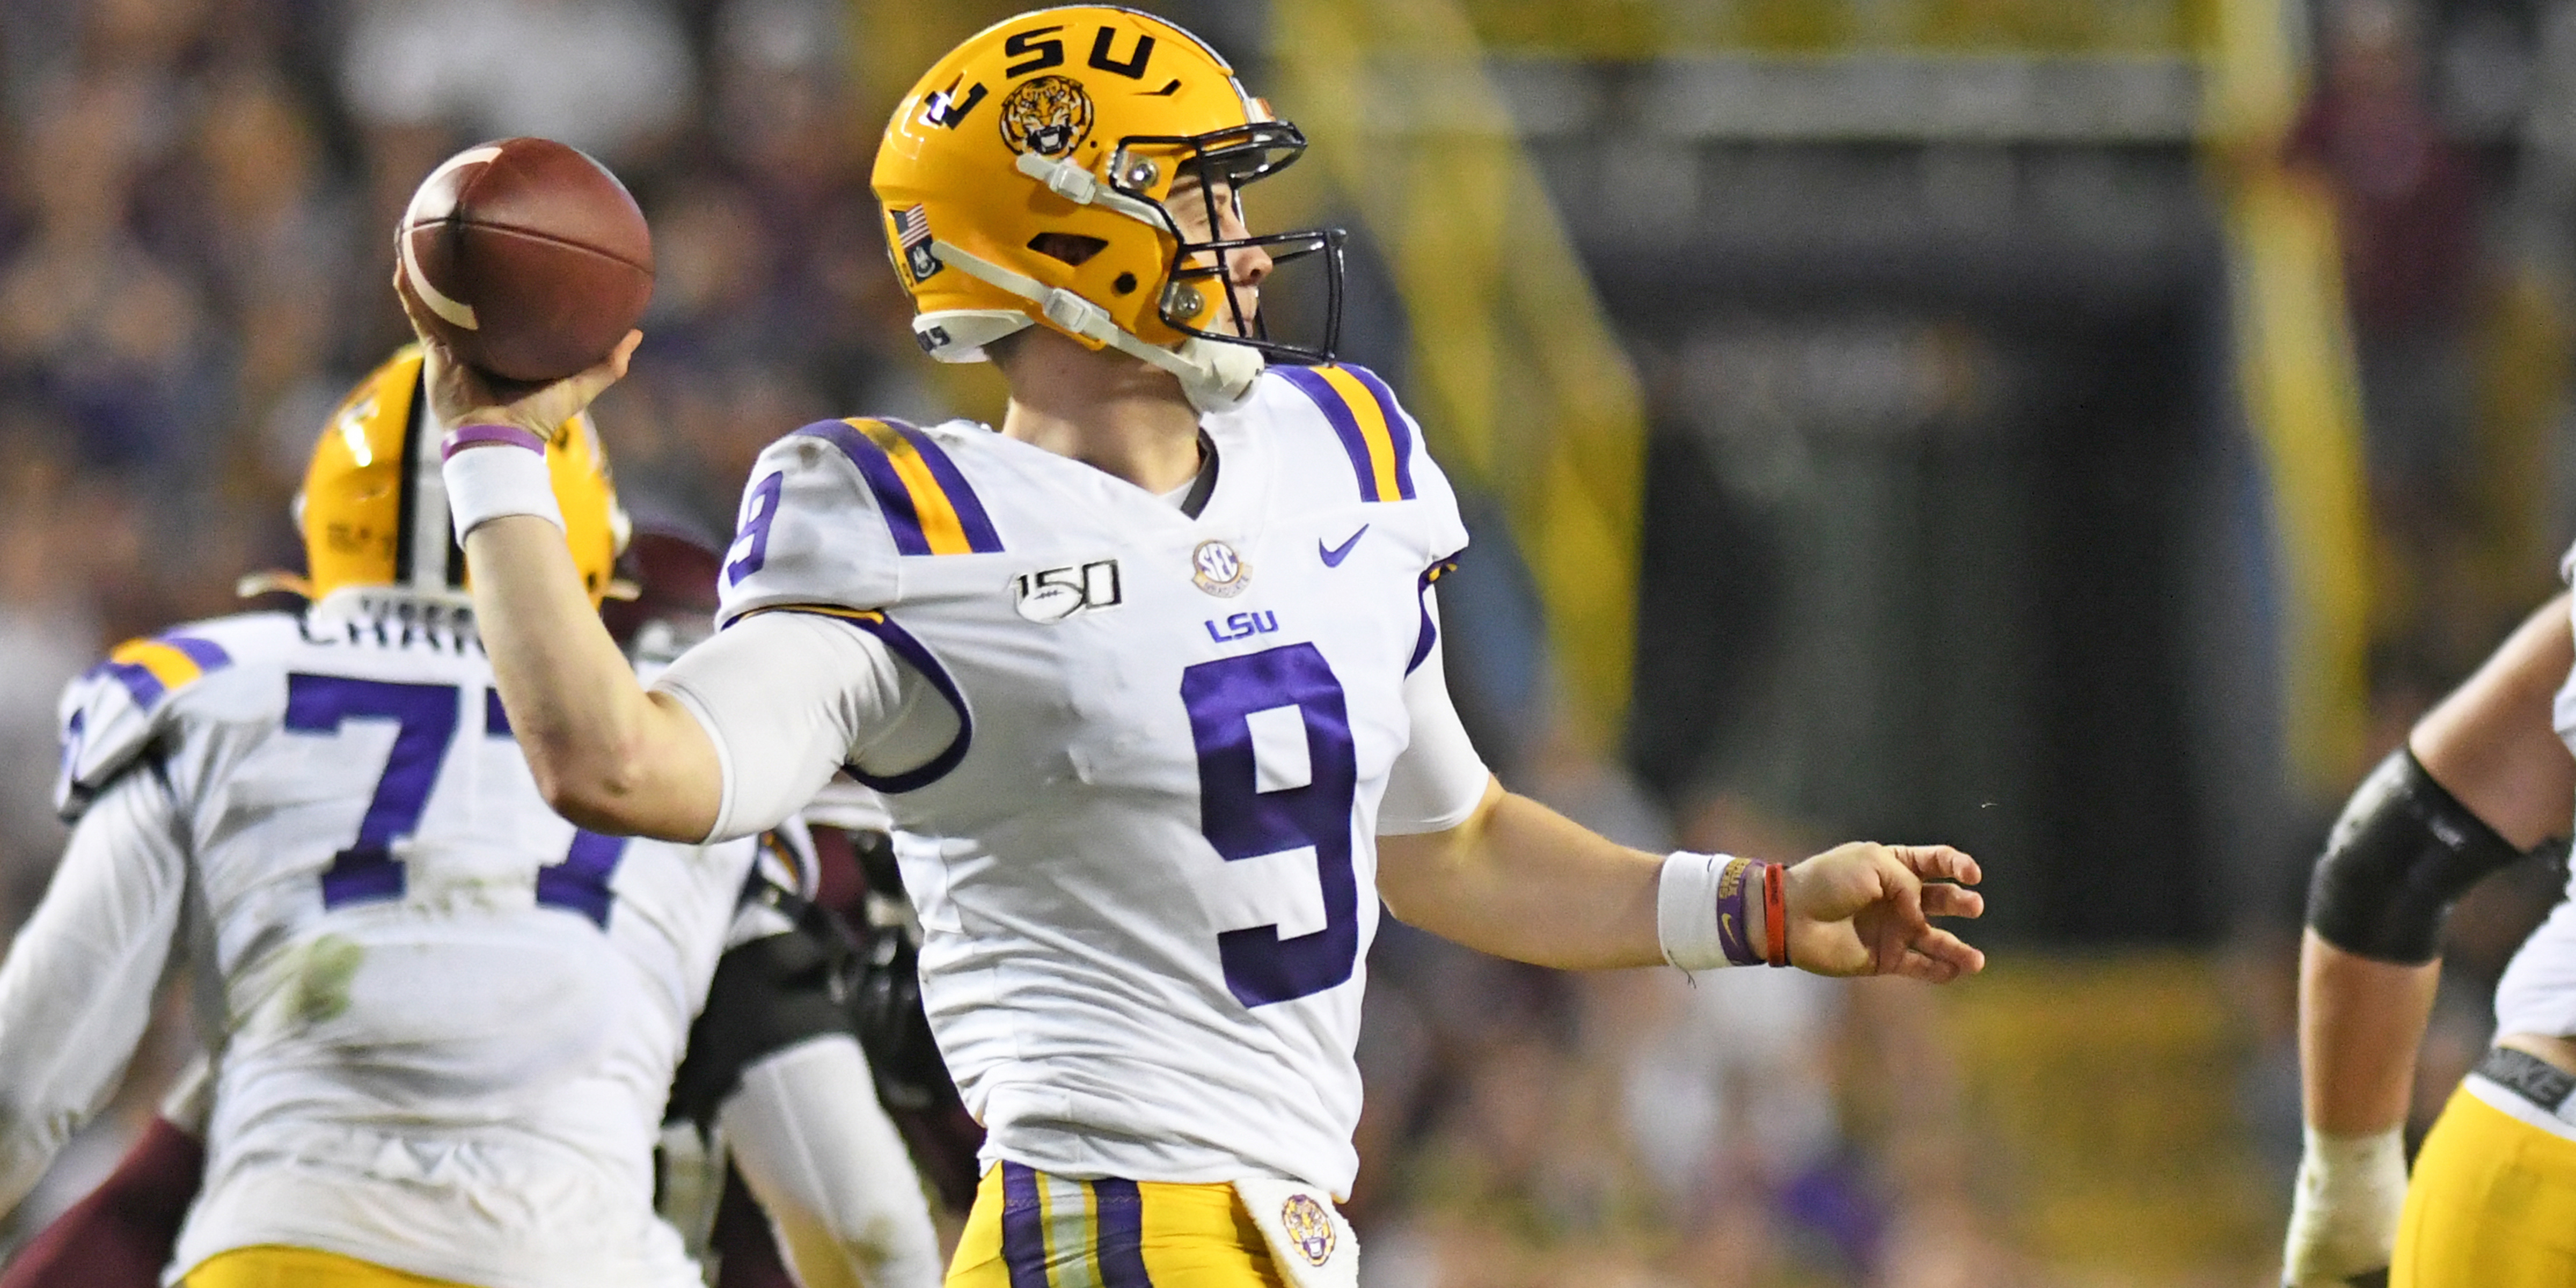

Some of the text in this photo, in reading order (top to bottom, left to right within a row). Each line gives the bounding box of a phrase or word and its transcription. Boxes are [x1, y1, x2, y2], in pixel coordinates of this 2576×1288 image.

[924, 25, 1156, 130] LSU
[727, 470, 784, 588] 9
[1198, 543, 1238, 581] SEC
[1017, 559, 1122, 620] 150
[1204, 610, 1279, 643] LSU
[1180, 641, 1358, 1008] 9
